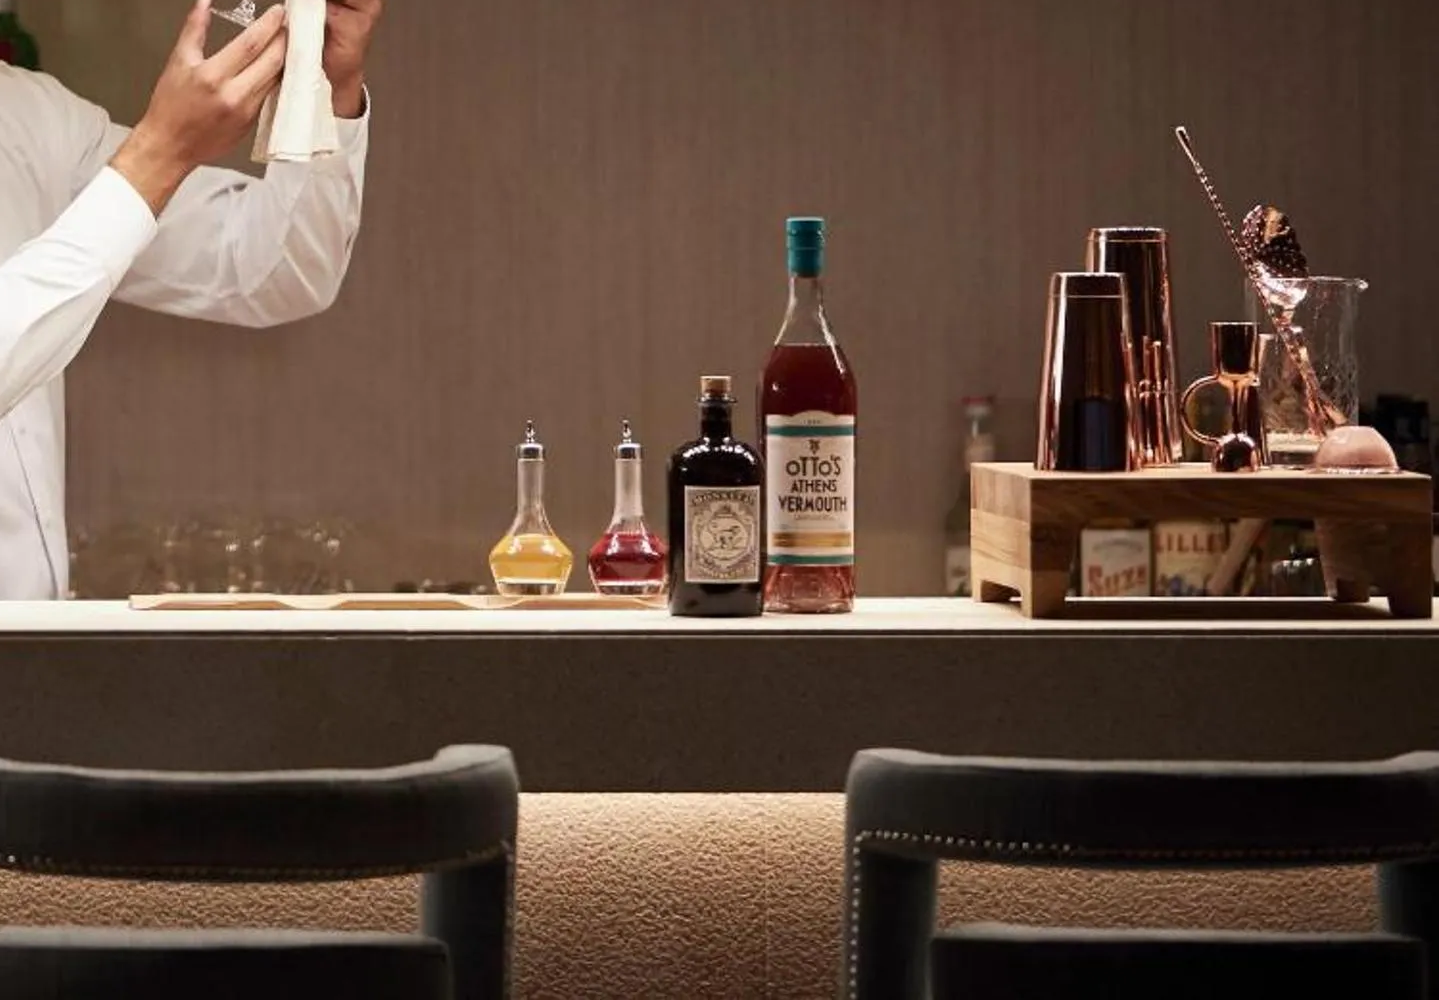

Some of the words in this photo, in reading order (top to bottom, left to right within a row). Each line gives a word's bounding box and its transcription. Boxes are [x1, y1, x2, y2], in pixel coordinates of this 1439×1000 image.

[785, 454, 842, 477] OTTO'S
[790, 479, 837, 494] ATHENS
[778, 495, 848, 513] VERMOUTH
